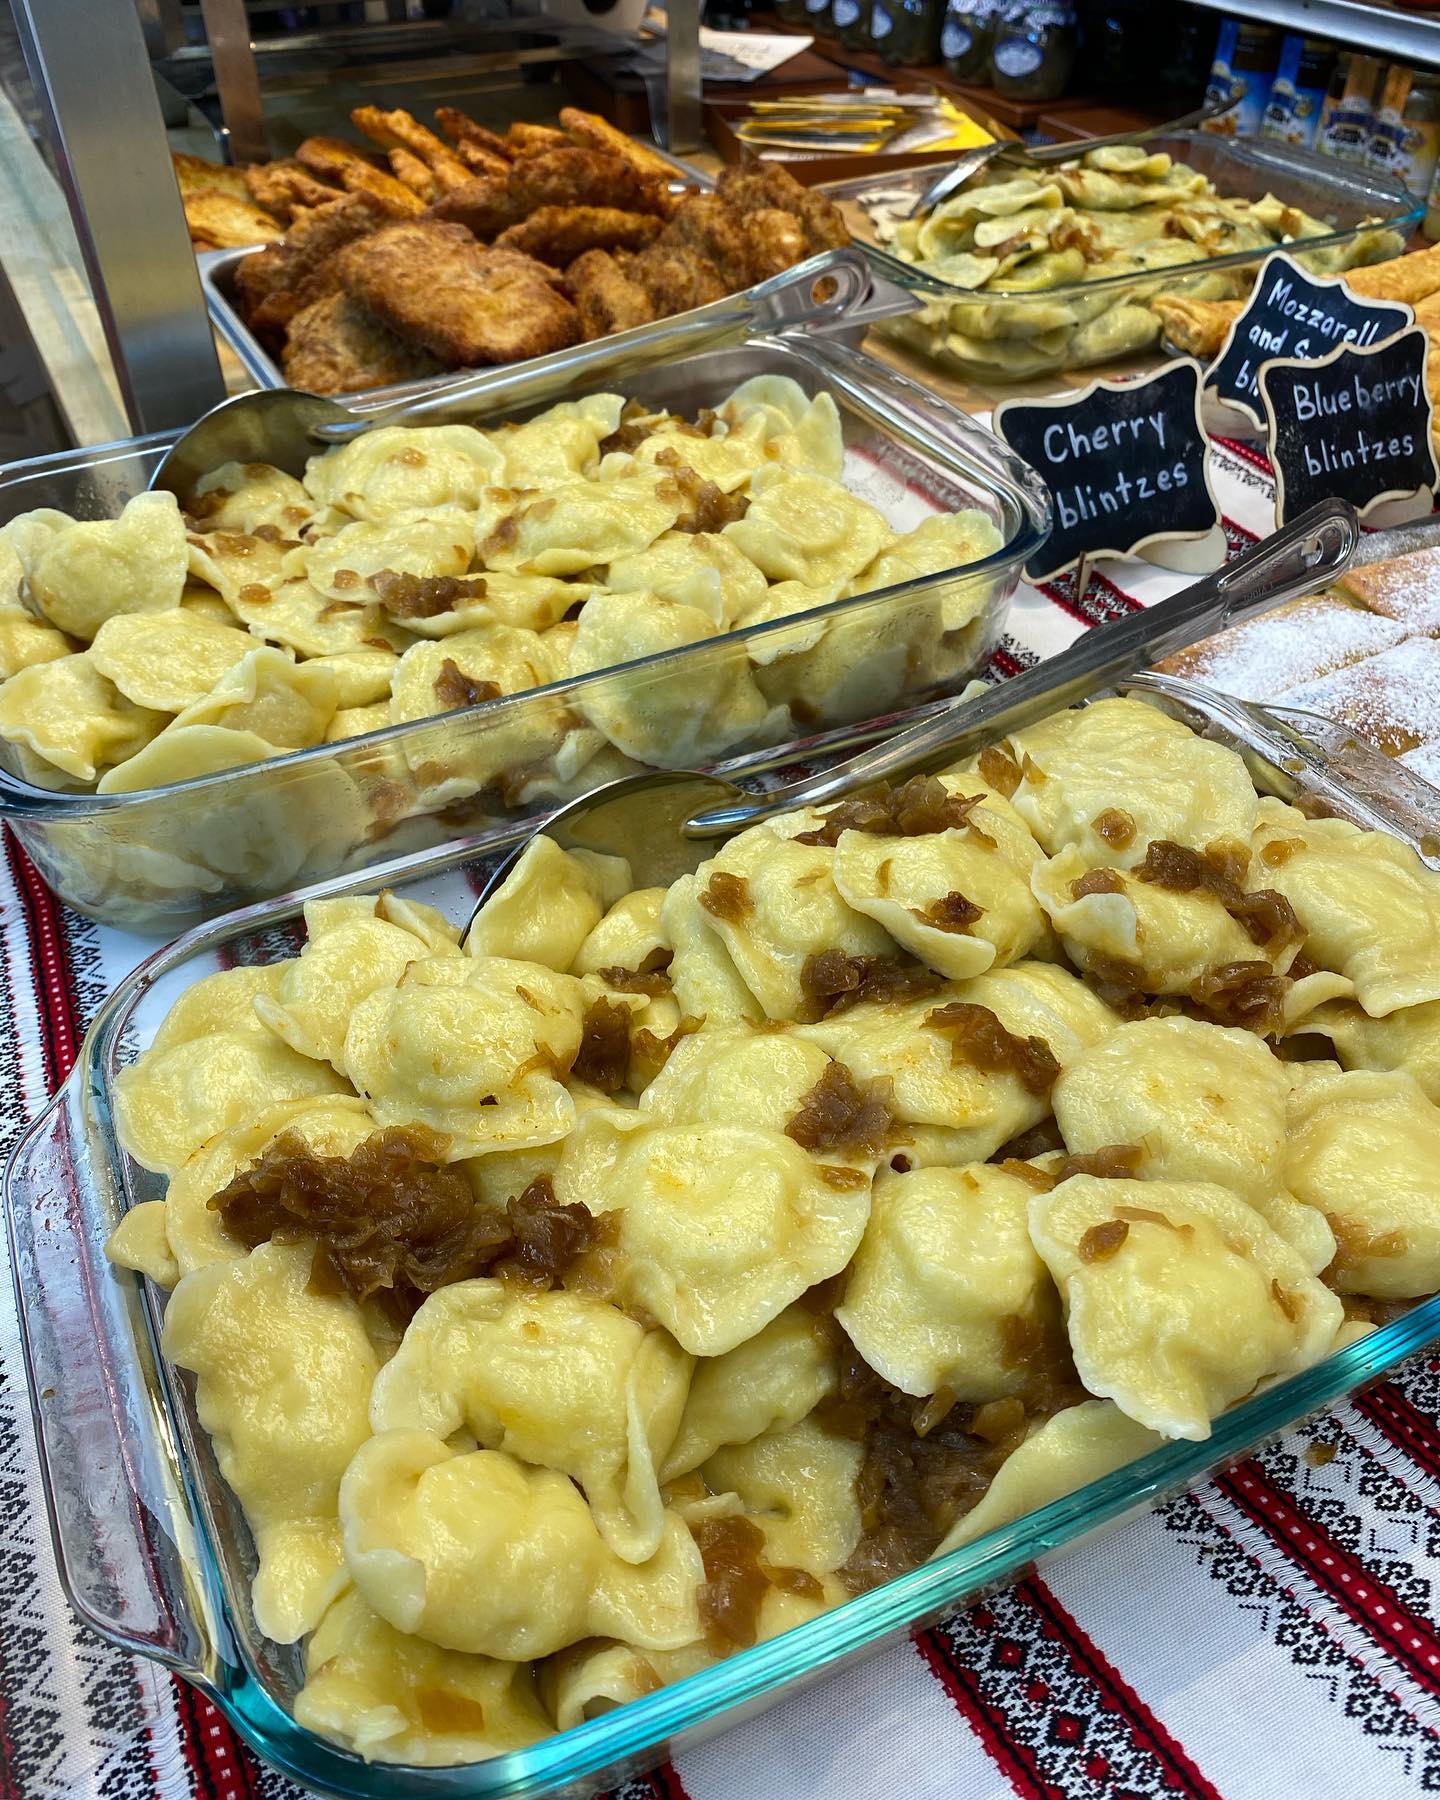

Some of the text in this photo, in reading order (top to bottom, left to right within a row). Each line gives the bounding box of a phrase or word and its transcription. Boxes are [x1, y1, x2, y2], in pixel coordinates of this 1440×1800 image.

[1249, 324, 1289, 355] and
[1293, 374, 1420, 421] Blueberry
[1043, 411, 1166, 463] Cherry
[1304, 430, 1414, 477] blintzes
[1056, 462, 1188, 529] blintzes
